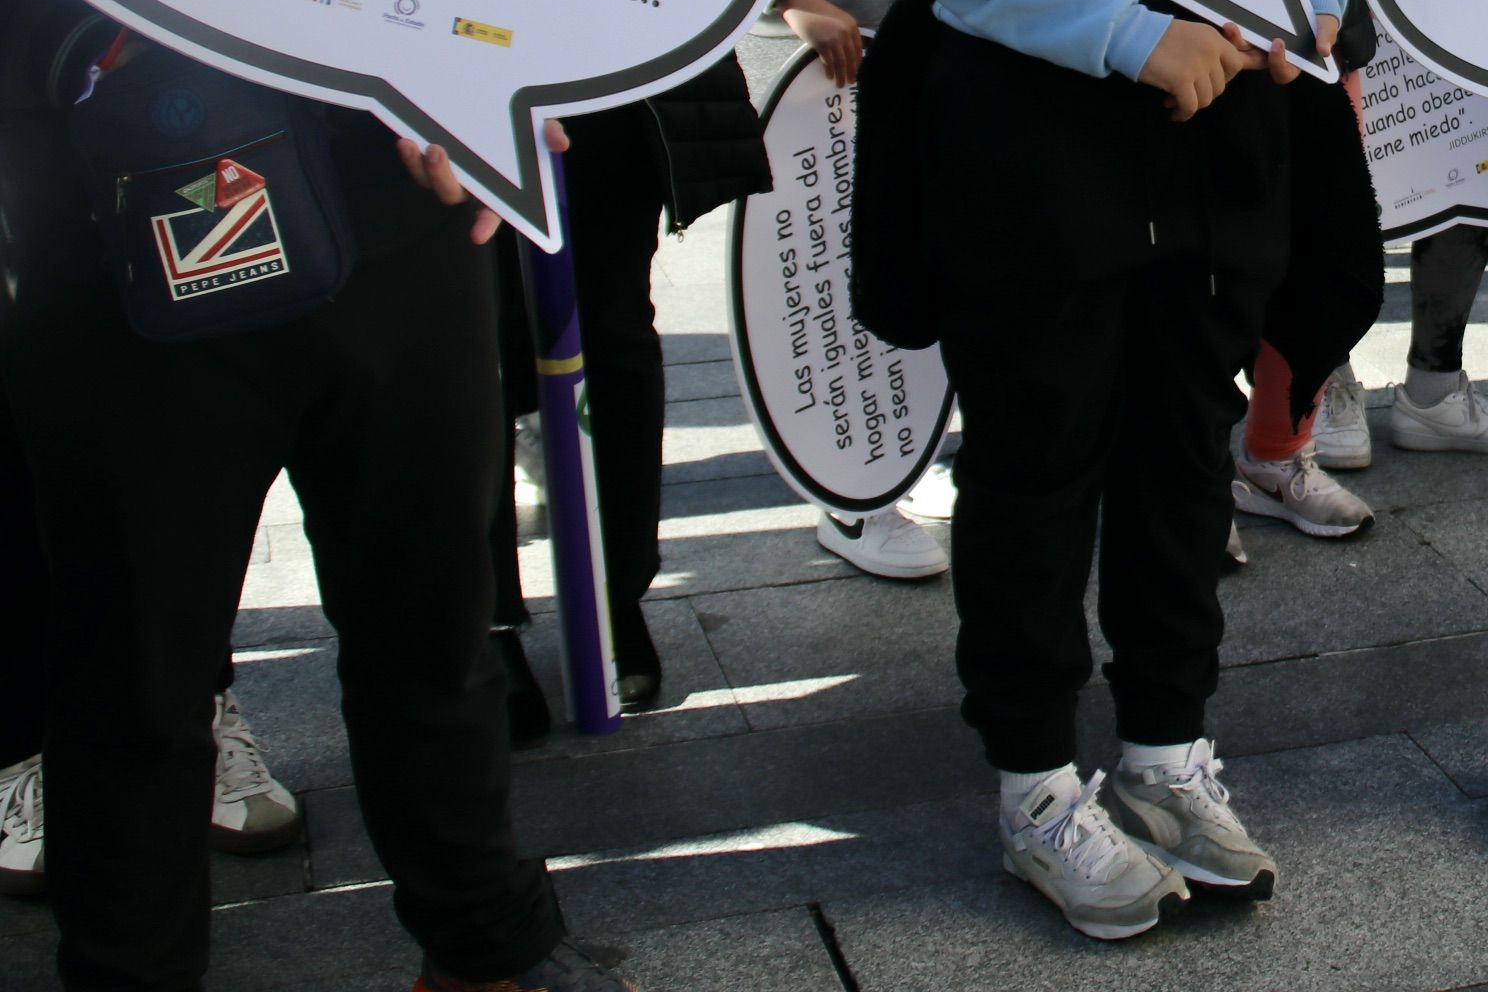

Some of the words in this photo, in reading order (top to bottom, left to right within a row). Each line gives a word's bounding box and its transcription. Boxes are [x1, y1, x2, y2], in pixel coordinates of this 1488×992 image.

[1404, 72, 1443, 93] hac
[1363, 103, 1416, 137] uando
[793, 147, 818, 187] del
[825, 94, 853, 214] hombres
[1367, 139, 1405, 162] iene
[221, 166, 240, 184] NO
[776, 209, 793, 240] no
[806, 195, 830, 272] fuera
[180, 278, 220, 294] PEPE
[229, 262, 279, 282] JEANS
[780, 248, 810, 358] mujeres
[813, 279, 846, 372] iguales
[795, 366, 816, 413] Las
[888, 360, 908, 419] sean
[824, 376, 852, 449] serán
[861, 391, 885, 465] hogar
[897, 427, 915, 457] no
[1030, 794, 1055, 820] PUMA
